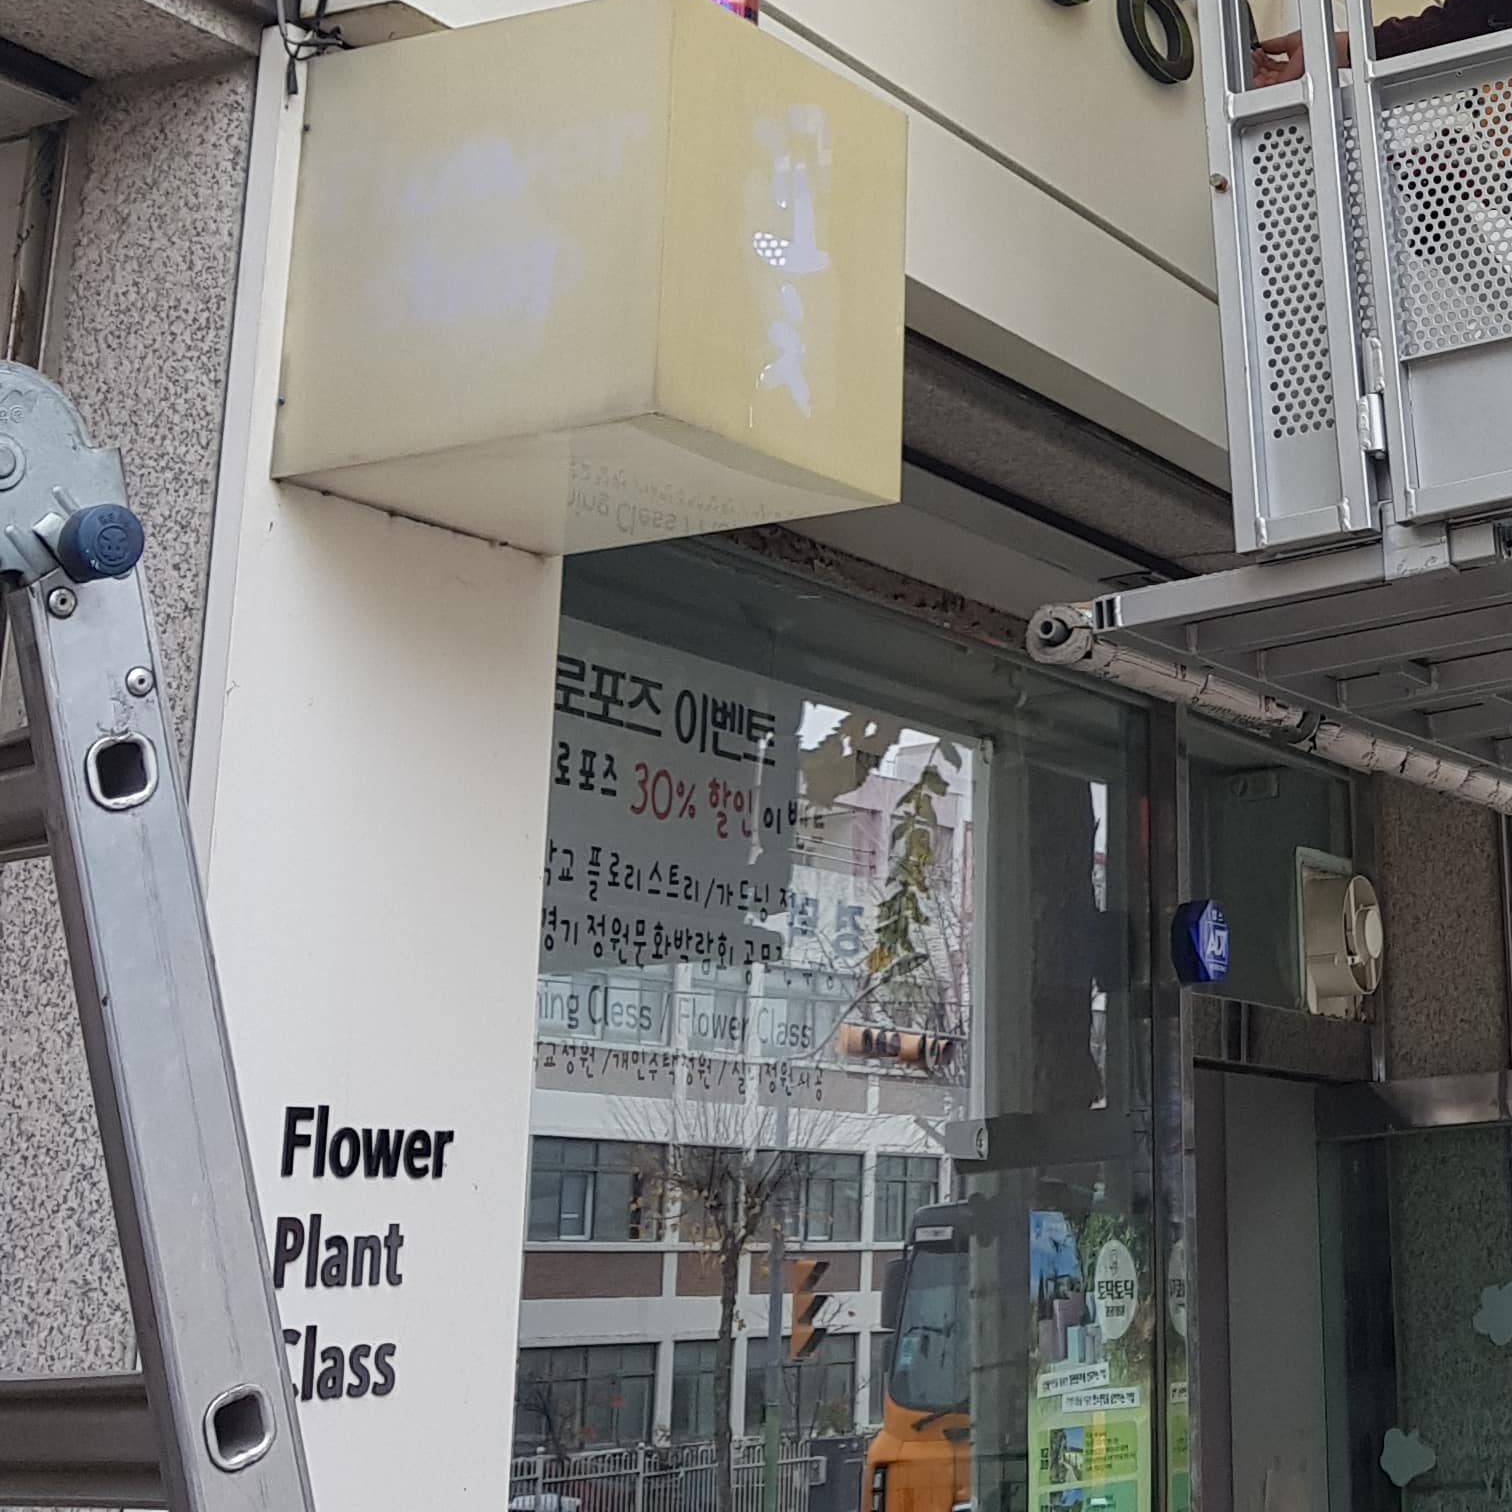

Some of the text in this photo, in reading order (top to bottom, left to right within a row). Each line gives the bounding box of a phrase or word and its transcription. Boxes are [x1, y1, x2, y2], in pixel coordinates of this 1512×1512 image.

[675, 689, 776, 767] 이벤트
[554, 742, 618, 797] 로포즈
[630, 762, 697, 820] 30%
[708, 777, 753, 839] 할인
[678, 997, 749, 1044] Flower
[757, 1007, 814, 1049] Class
[280, 1104, 455, 1179] Flower
[273, 1213, 405, 1289] Plant
